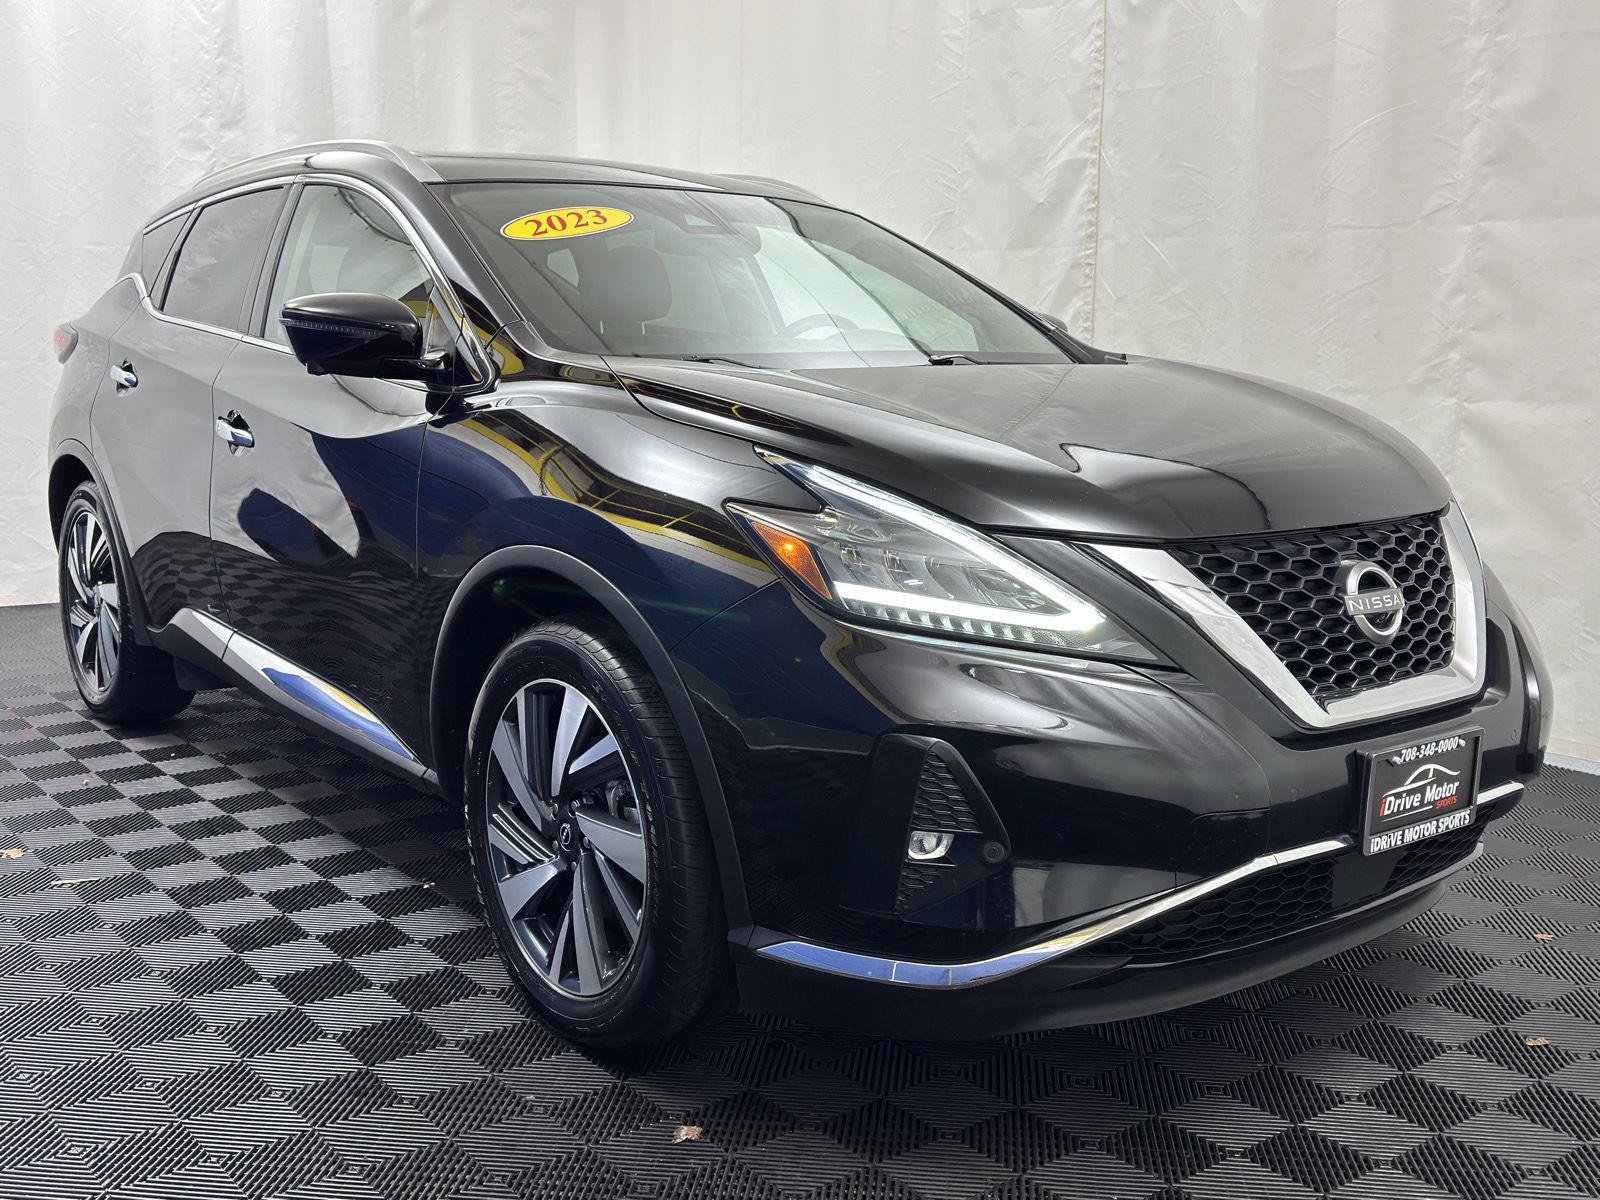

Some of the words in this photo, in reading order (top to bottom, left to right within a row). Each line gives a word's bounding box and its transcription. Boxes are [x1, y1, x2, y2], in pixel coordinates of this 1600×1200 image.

[524, 209, 608, 237] 2023
[1348, 592, 1403, 612] NISSA
[1400, 736, 1459, 763] 708-348-0000
[1379, 793, 1421, 817] iDrive
[1424, 781, 1460, 804] Motor
[1403, 820, 1437, 844] MOTOR
[1438, 809, 1471, 833] SPORTS
